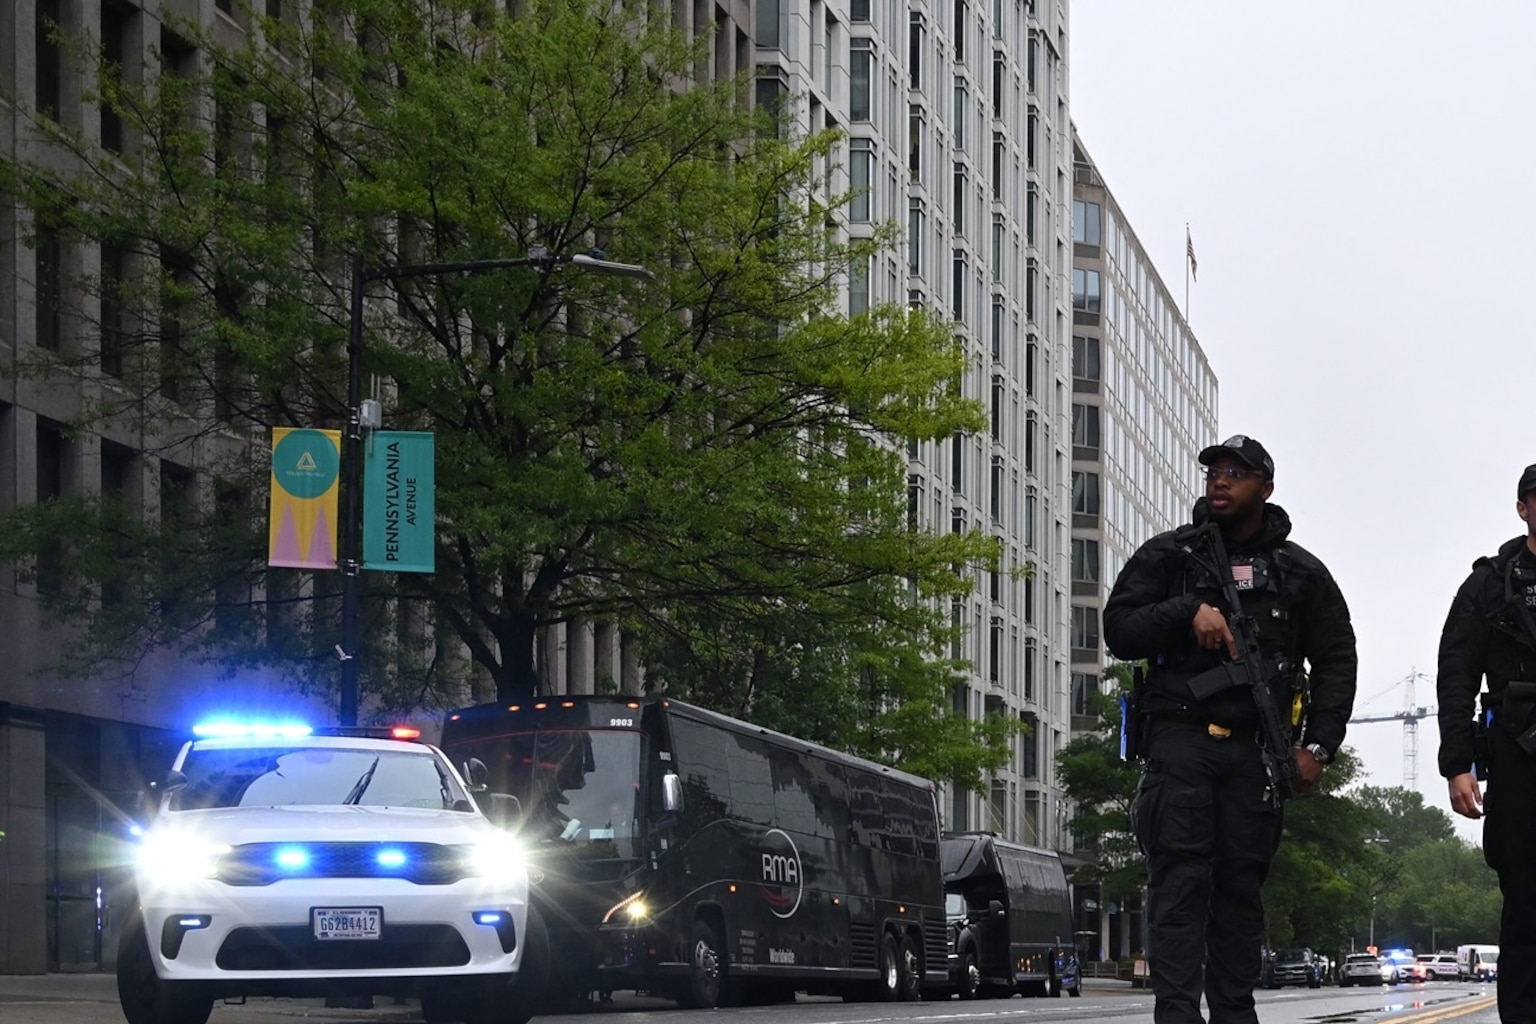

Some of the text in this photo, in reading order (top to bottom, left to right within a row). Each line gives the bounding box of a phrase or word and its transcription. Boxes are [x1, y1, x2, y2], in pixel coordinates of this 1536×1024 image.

[386, 441, 400, 562] PENNSYLVANIA
[406, 478, 417, 526] AVENUE
[610, 718, 633, 727] 9903
[762, 853, 798, 884] RMA
